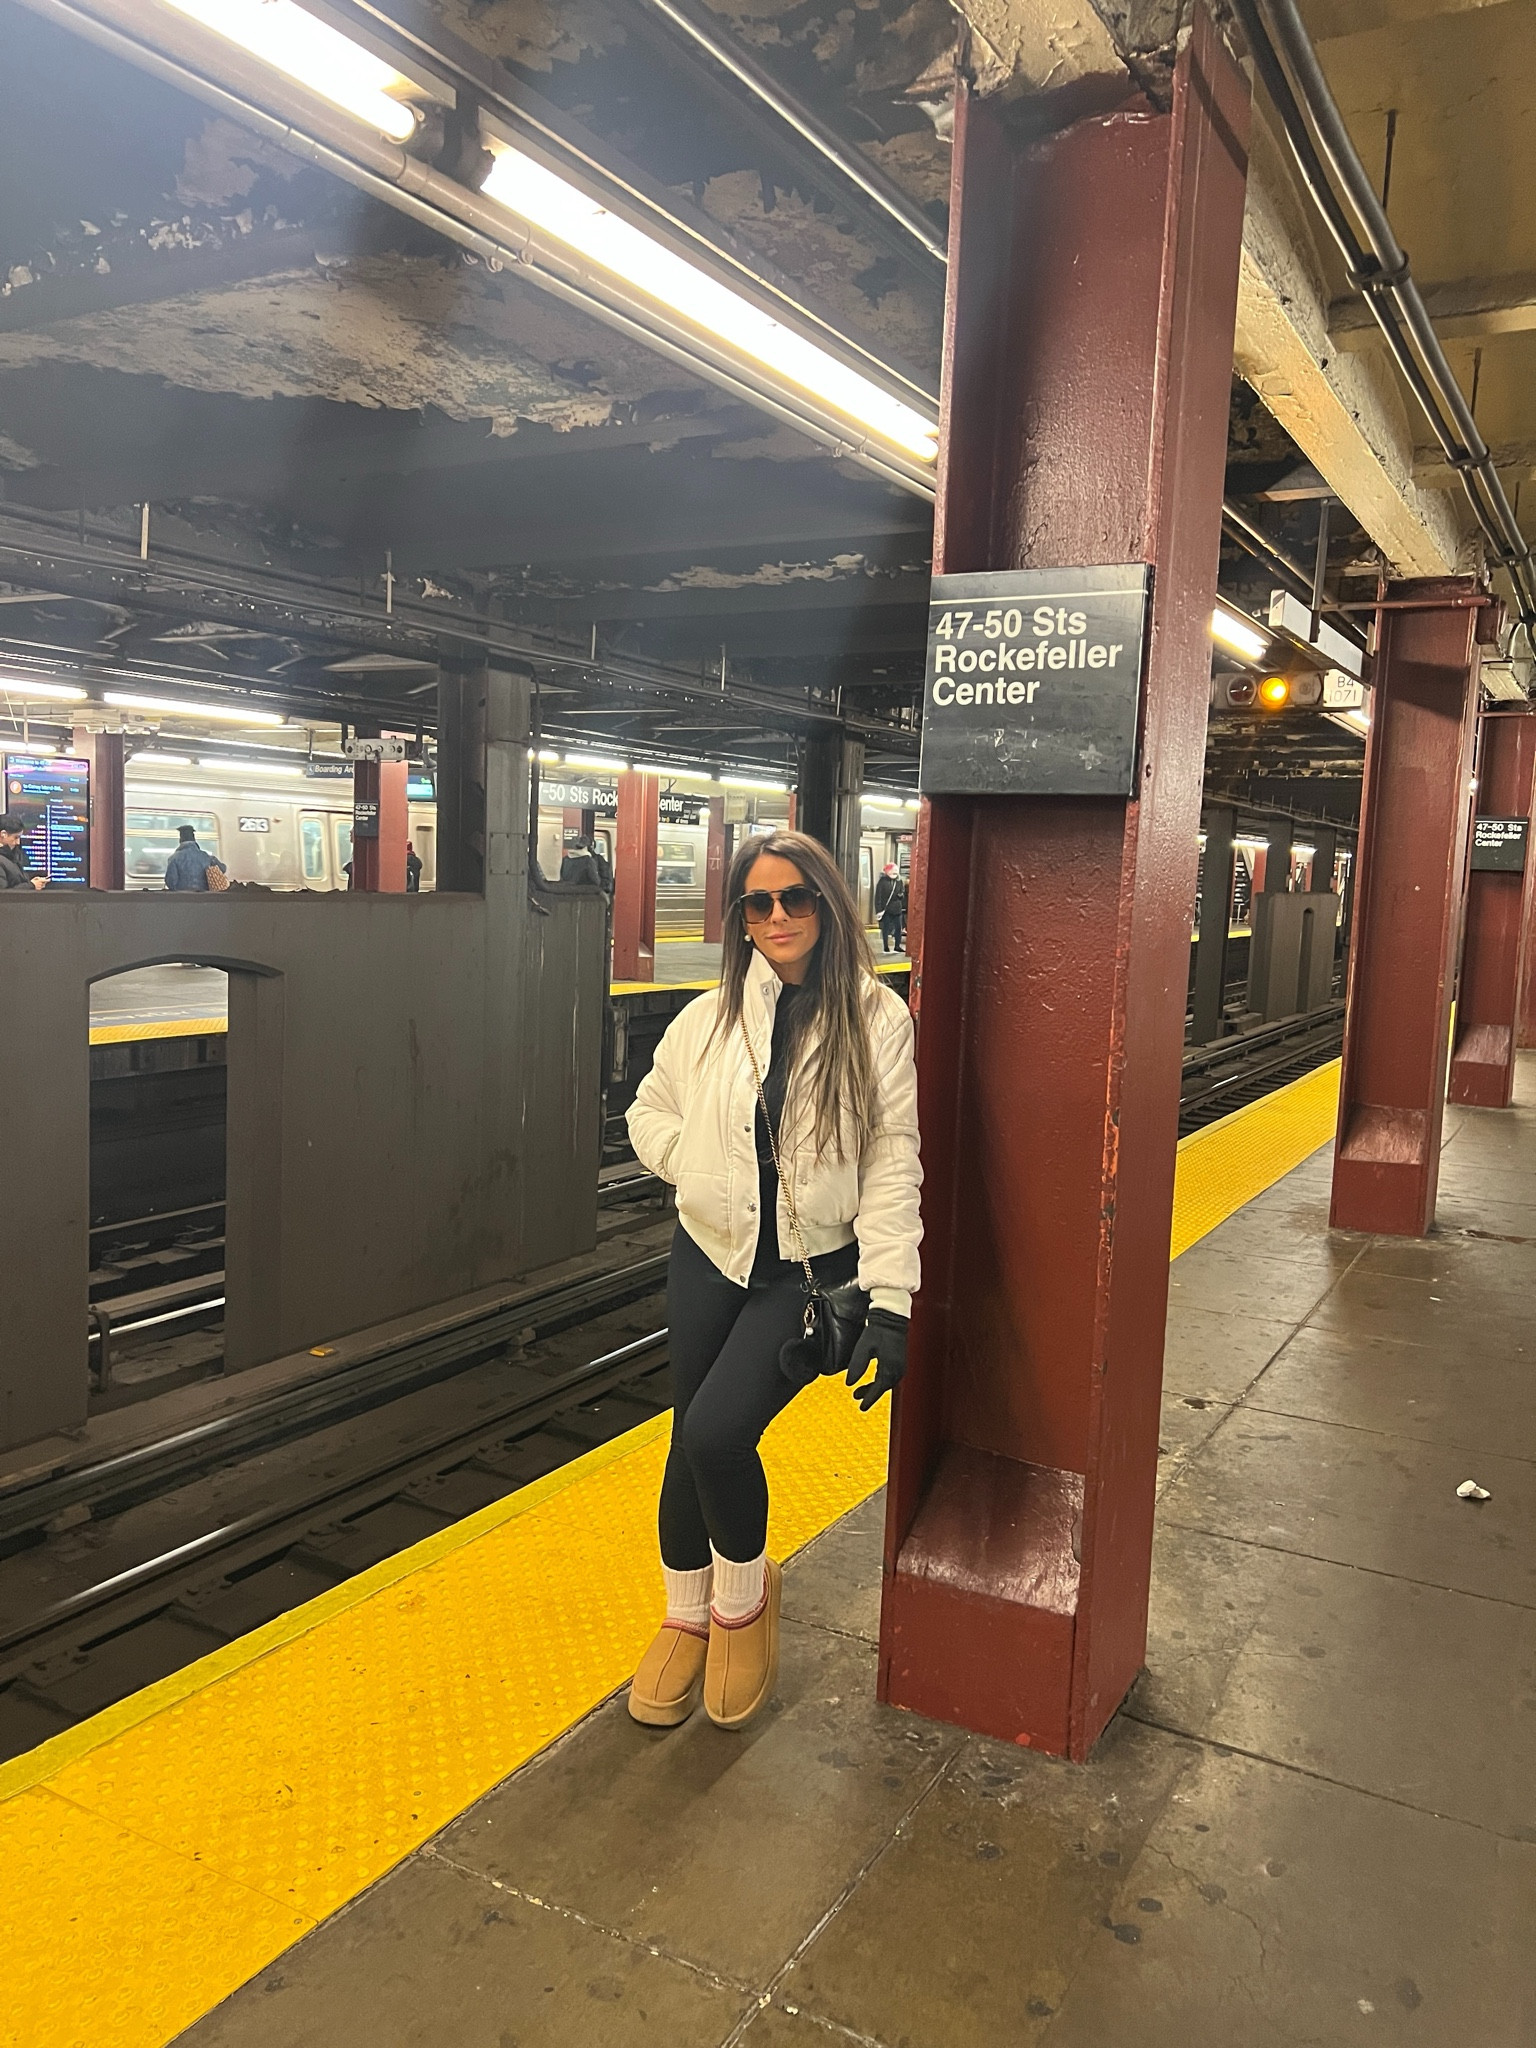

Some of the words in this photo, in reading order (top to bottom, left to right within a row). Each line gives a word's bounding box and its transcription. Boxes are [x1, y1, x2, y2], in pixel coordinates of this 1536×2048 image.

[935, 608, 1023, 640] 47-50
[1032, 605, 1087, 637] Sts
[934, 639, 1123, 673] Rockefeller
[1337, 675, 1354, 688] B4
[932, 676, 1040, 706] Center
[1329, 689, 1356, 702] 1071
[314, 764, 343, 775] Boarding
[569, 785, 589, 804] Sts
[659, 796, 684, 812] enter
[1476, 823, 1505, 832] 47-50
[1507, 823, 1523, 832] Sts
[1475, 830, 1522, 840] Rockefeller
[1474, 838, 1504, 847] Center
